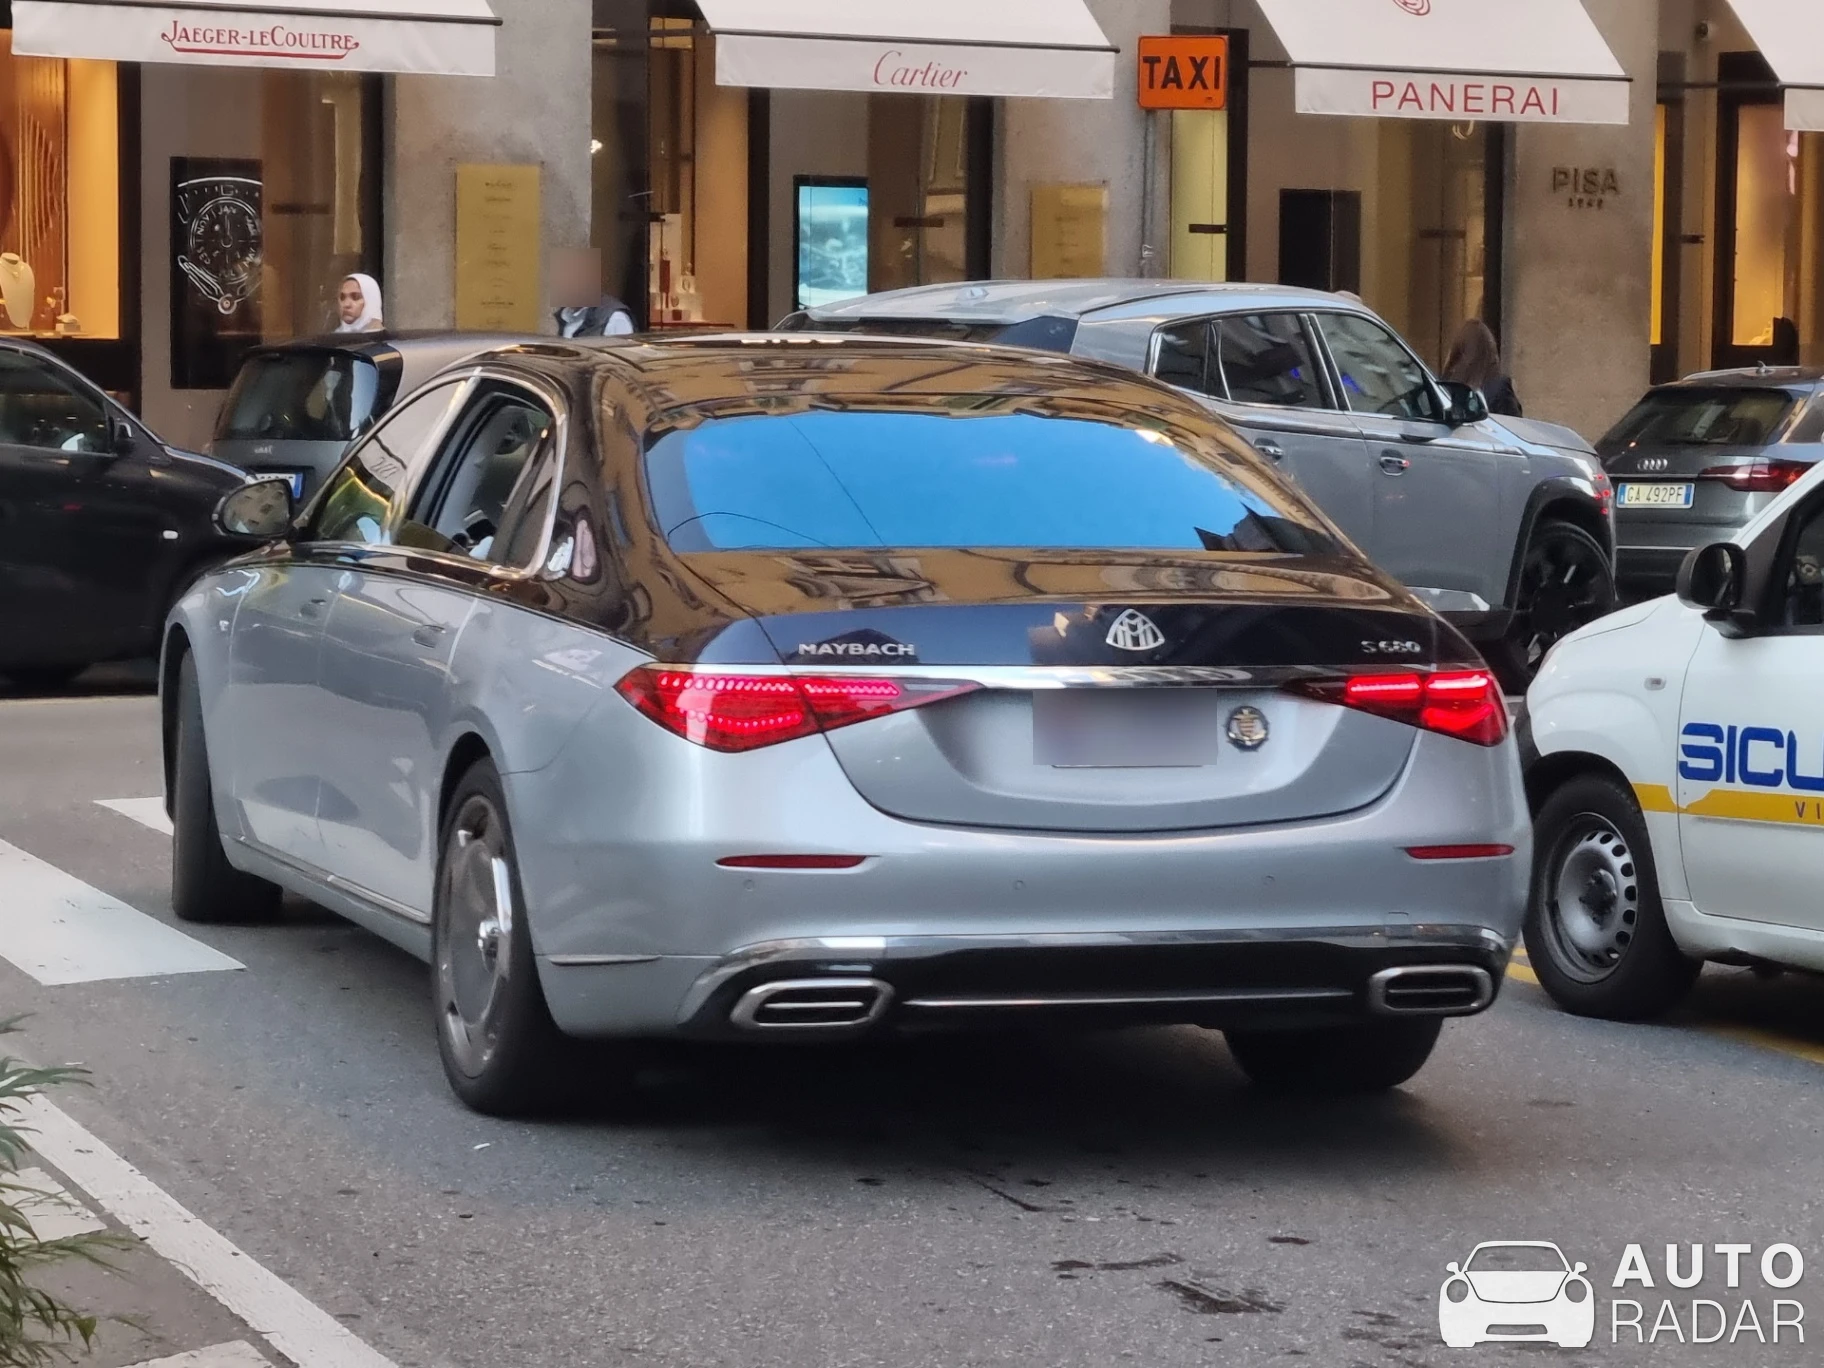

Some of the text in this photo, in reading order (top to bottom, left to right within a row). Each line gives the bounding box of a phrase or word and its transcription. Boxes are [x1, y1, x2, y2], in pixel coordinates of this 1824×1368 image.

[874, 50, 968, 87] Cartier
[1142, 55, 1221, 90] TAXI
[1372, 81, 1557, 115] PANERAI
[1552, 167, 1620, 194] PISA
[1627, 486, 1685, 503] GA 492PF
[798, 643, 915, 655] MAYBACH
